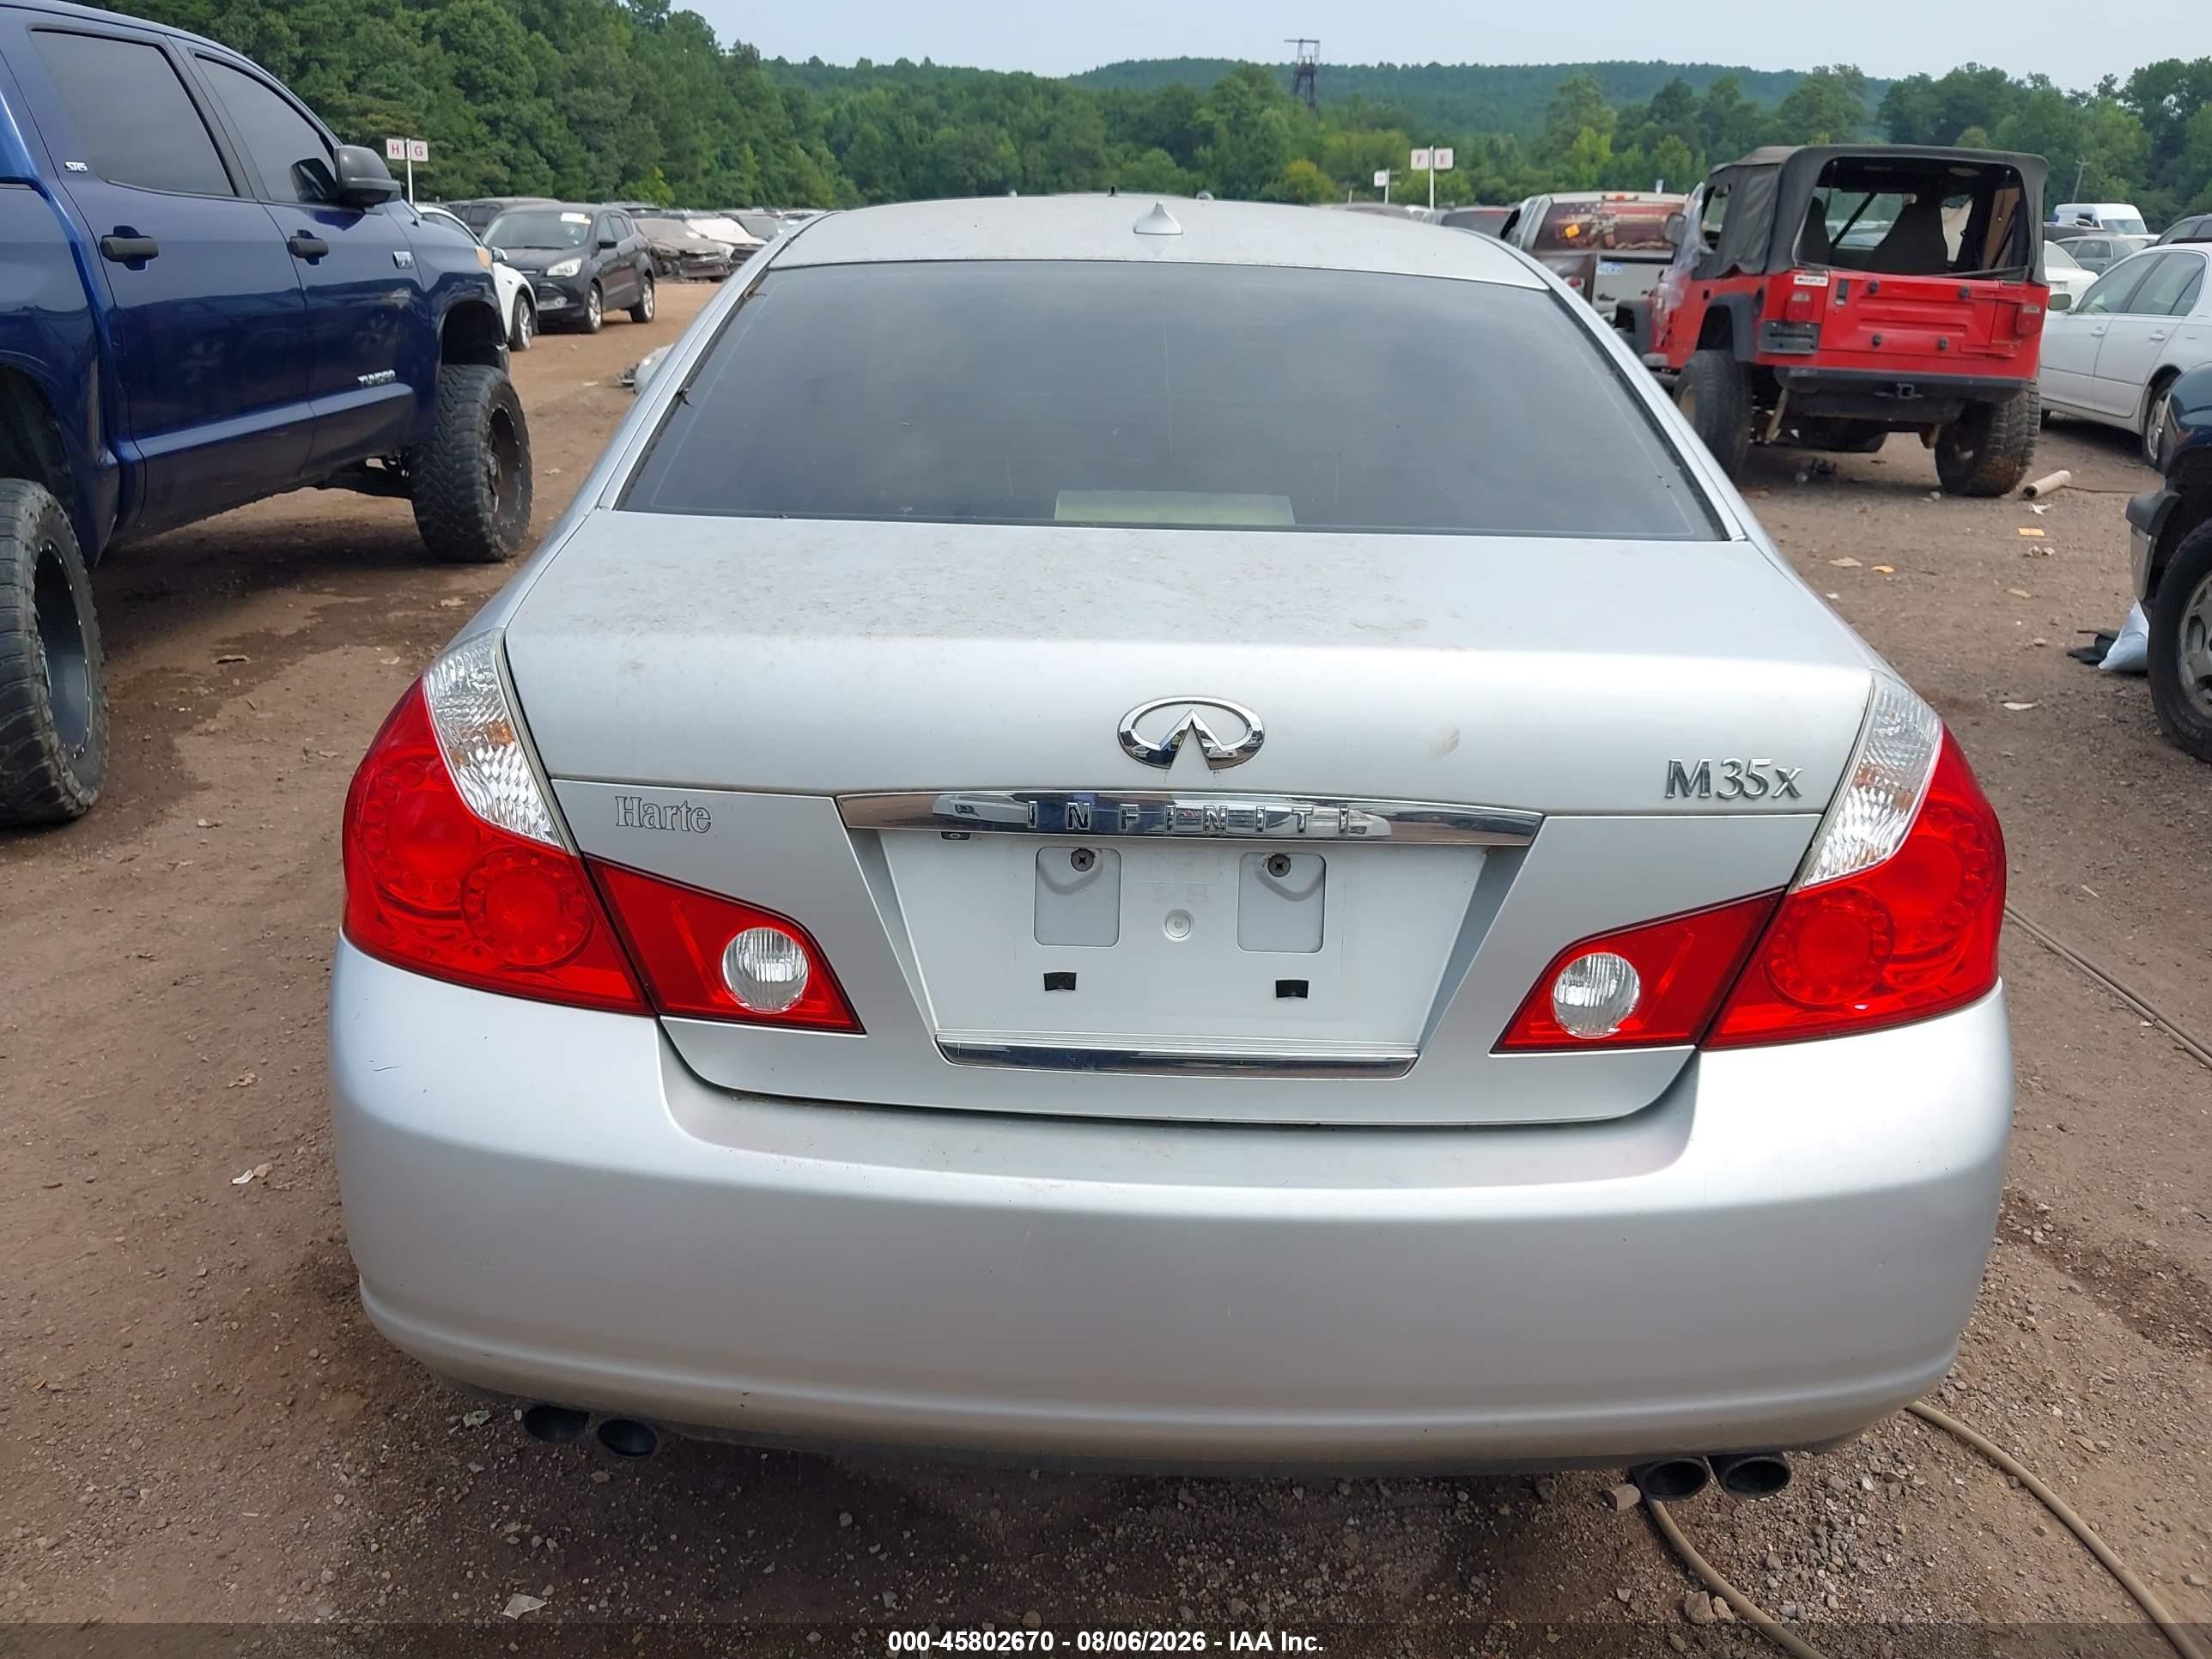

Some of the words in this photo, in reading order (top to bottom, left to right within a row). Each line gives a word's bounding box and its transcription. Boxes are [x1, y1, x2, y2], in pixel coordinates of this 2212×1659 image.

[392, 143, 399, 155] H
[414, 145, 423, 156] G
[615, 796, 712, 833] Harte
[1028, 800, 1349, 835] INFINITI
